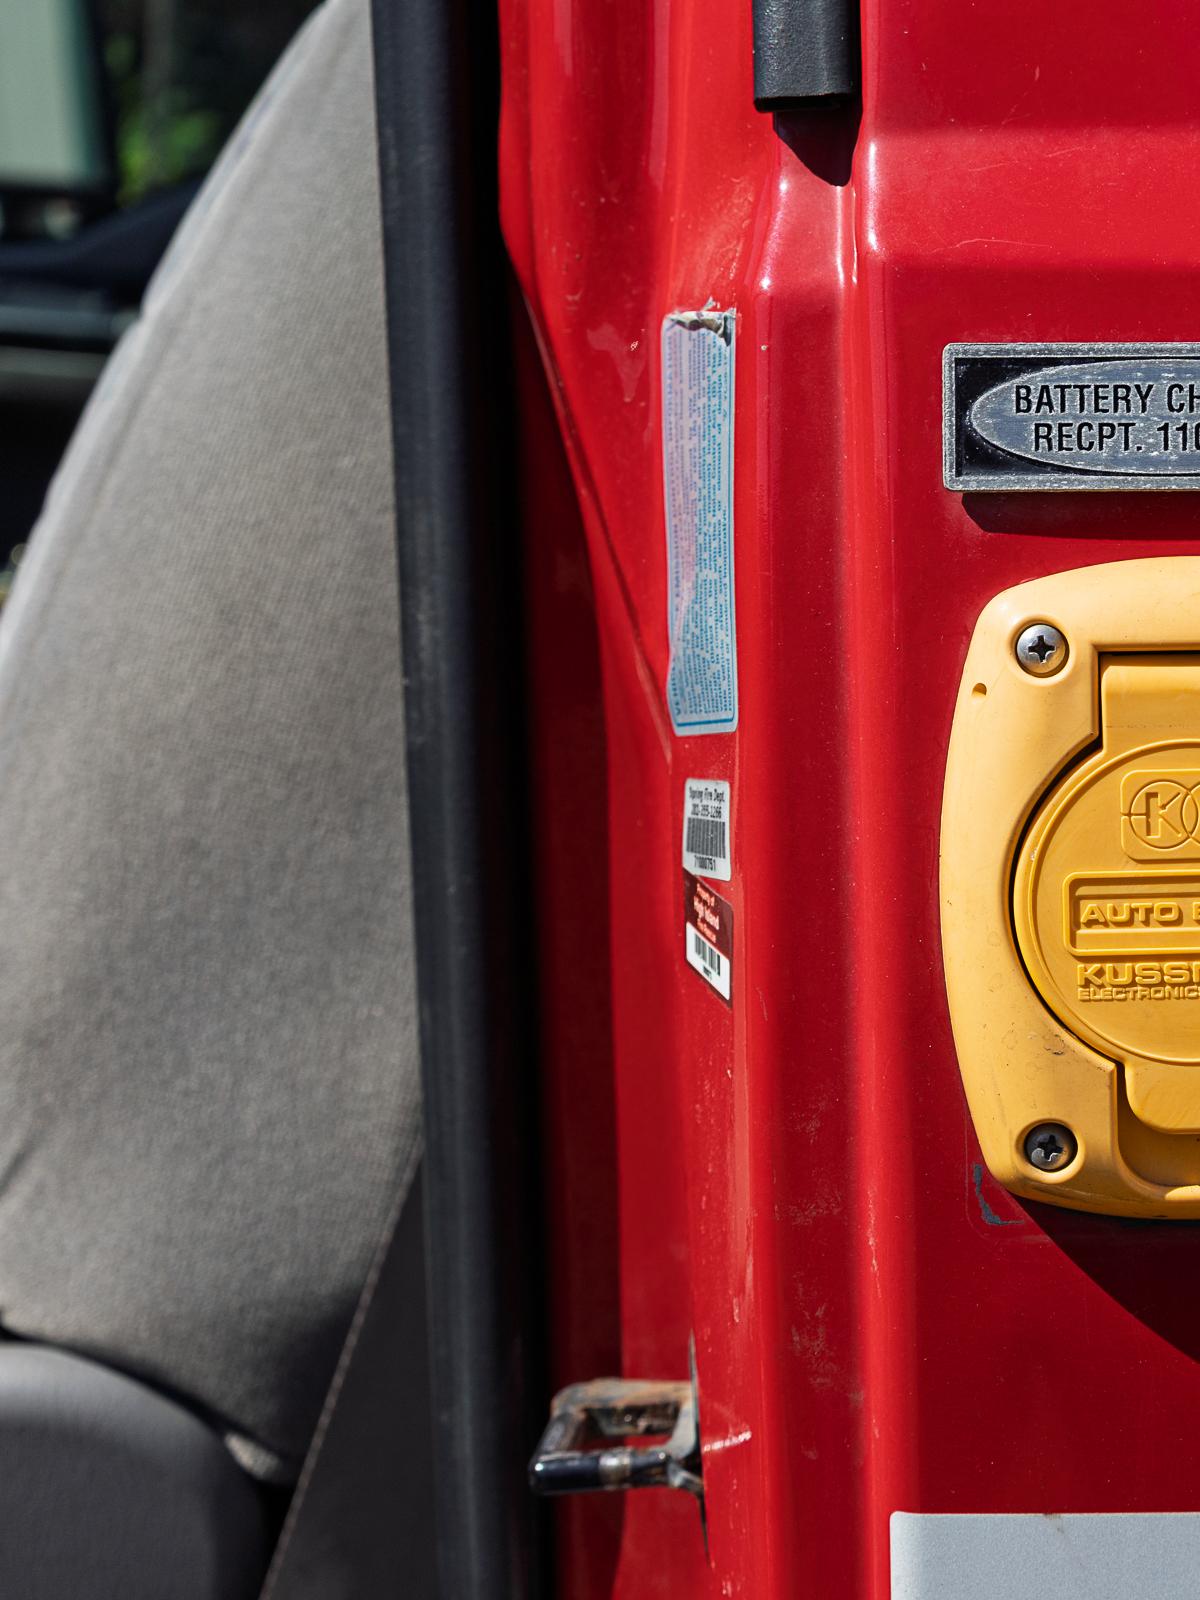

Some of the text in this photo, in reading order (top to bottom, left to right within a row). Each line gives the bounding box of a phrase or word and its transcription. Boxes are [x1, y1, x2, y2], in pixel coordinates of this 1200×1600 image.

[1015, 383, 1152, 414] BATTERY
[1033, 421, 1143, 452] RECPT.
[1080, 902, 1183, 926] AUTO
